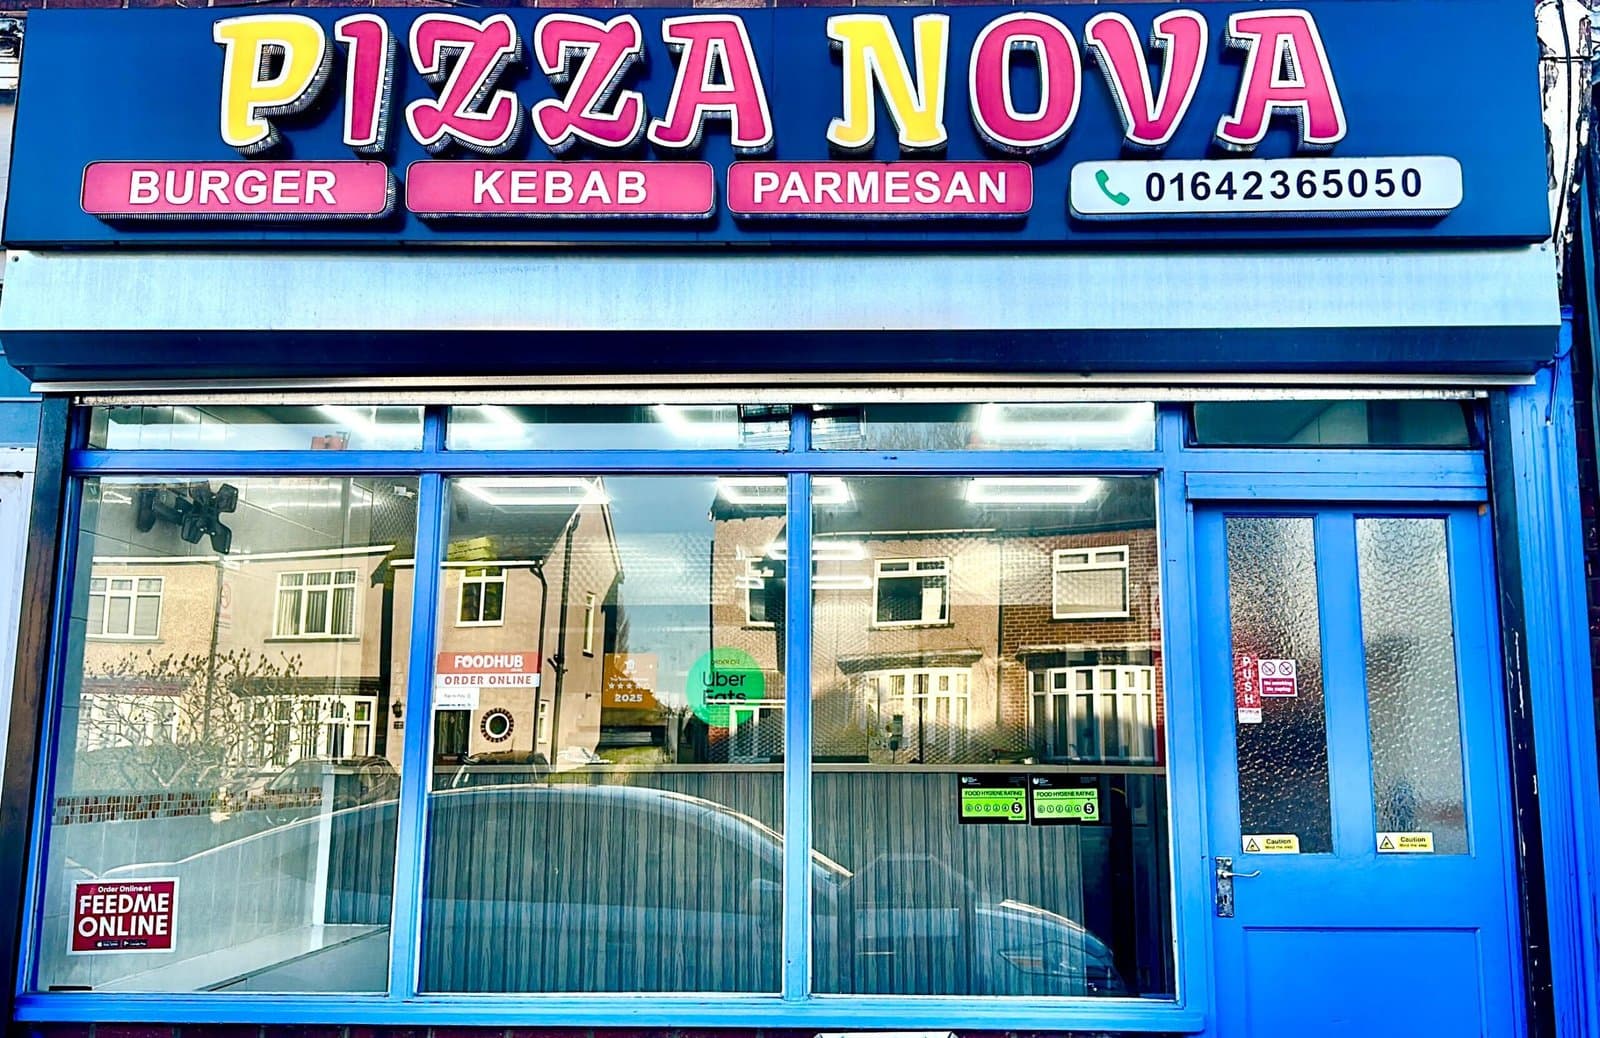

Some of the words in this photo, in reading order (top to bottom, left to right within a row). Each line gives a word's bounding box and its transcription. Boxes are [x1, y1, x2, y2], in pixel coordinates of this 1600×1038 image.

[213, 13, 774, 149] PIZZA
[826, 9, 1348, 149] NOVA
[128, 169, 337, 206] BURGER
[473, 169, 648, 206] KEBAB
[753, 170, 1008, 206] PARMESAN
[1145, 167, 1423, 202] 01642365050
[454, 655, 523, 668] FOODHUB
[444, 676, 484, 685] ORDER
[489, 675, 532, 685] ONLINE
[702, 671, 746, 686] Uber
[1242, 656, 1254, 704] PUSH
[615, 693, 643, 702] 2025
[702, 690, 747, 705] Eats
[1013, 803, 1020, 813] 5
[1086, 804, 1093, 813] 5
[79, 893, 170, 915] FEEDME
[78, 915, 168, 938] ONLINE
